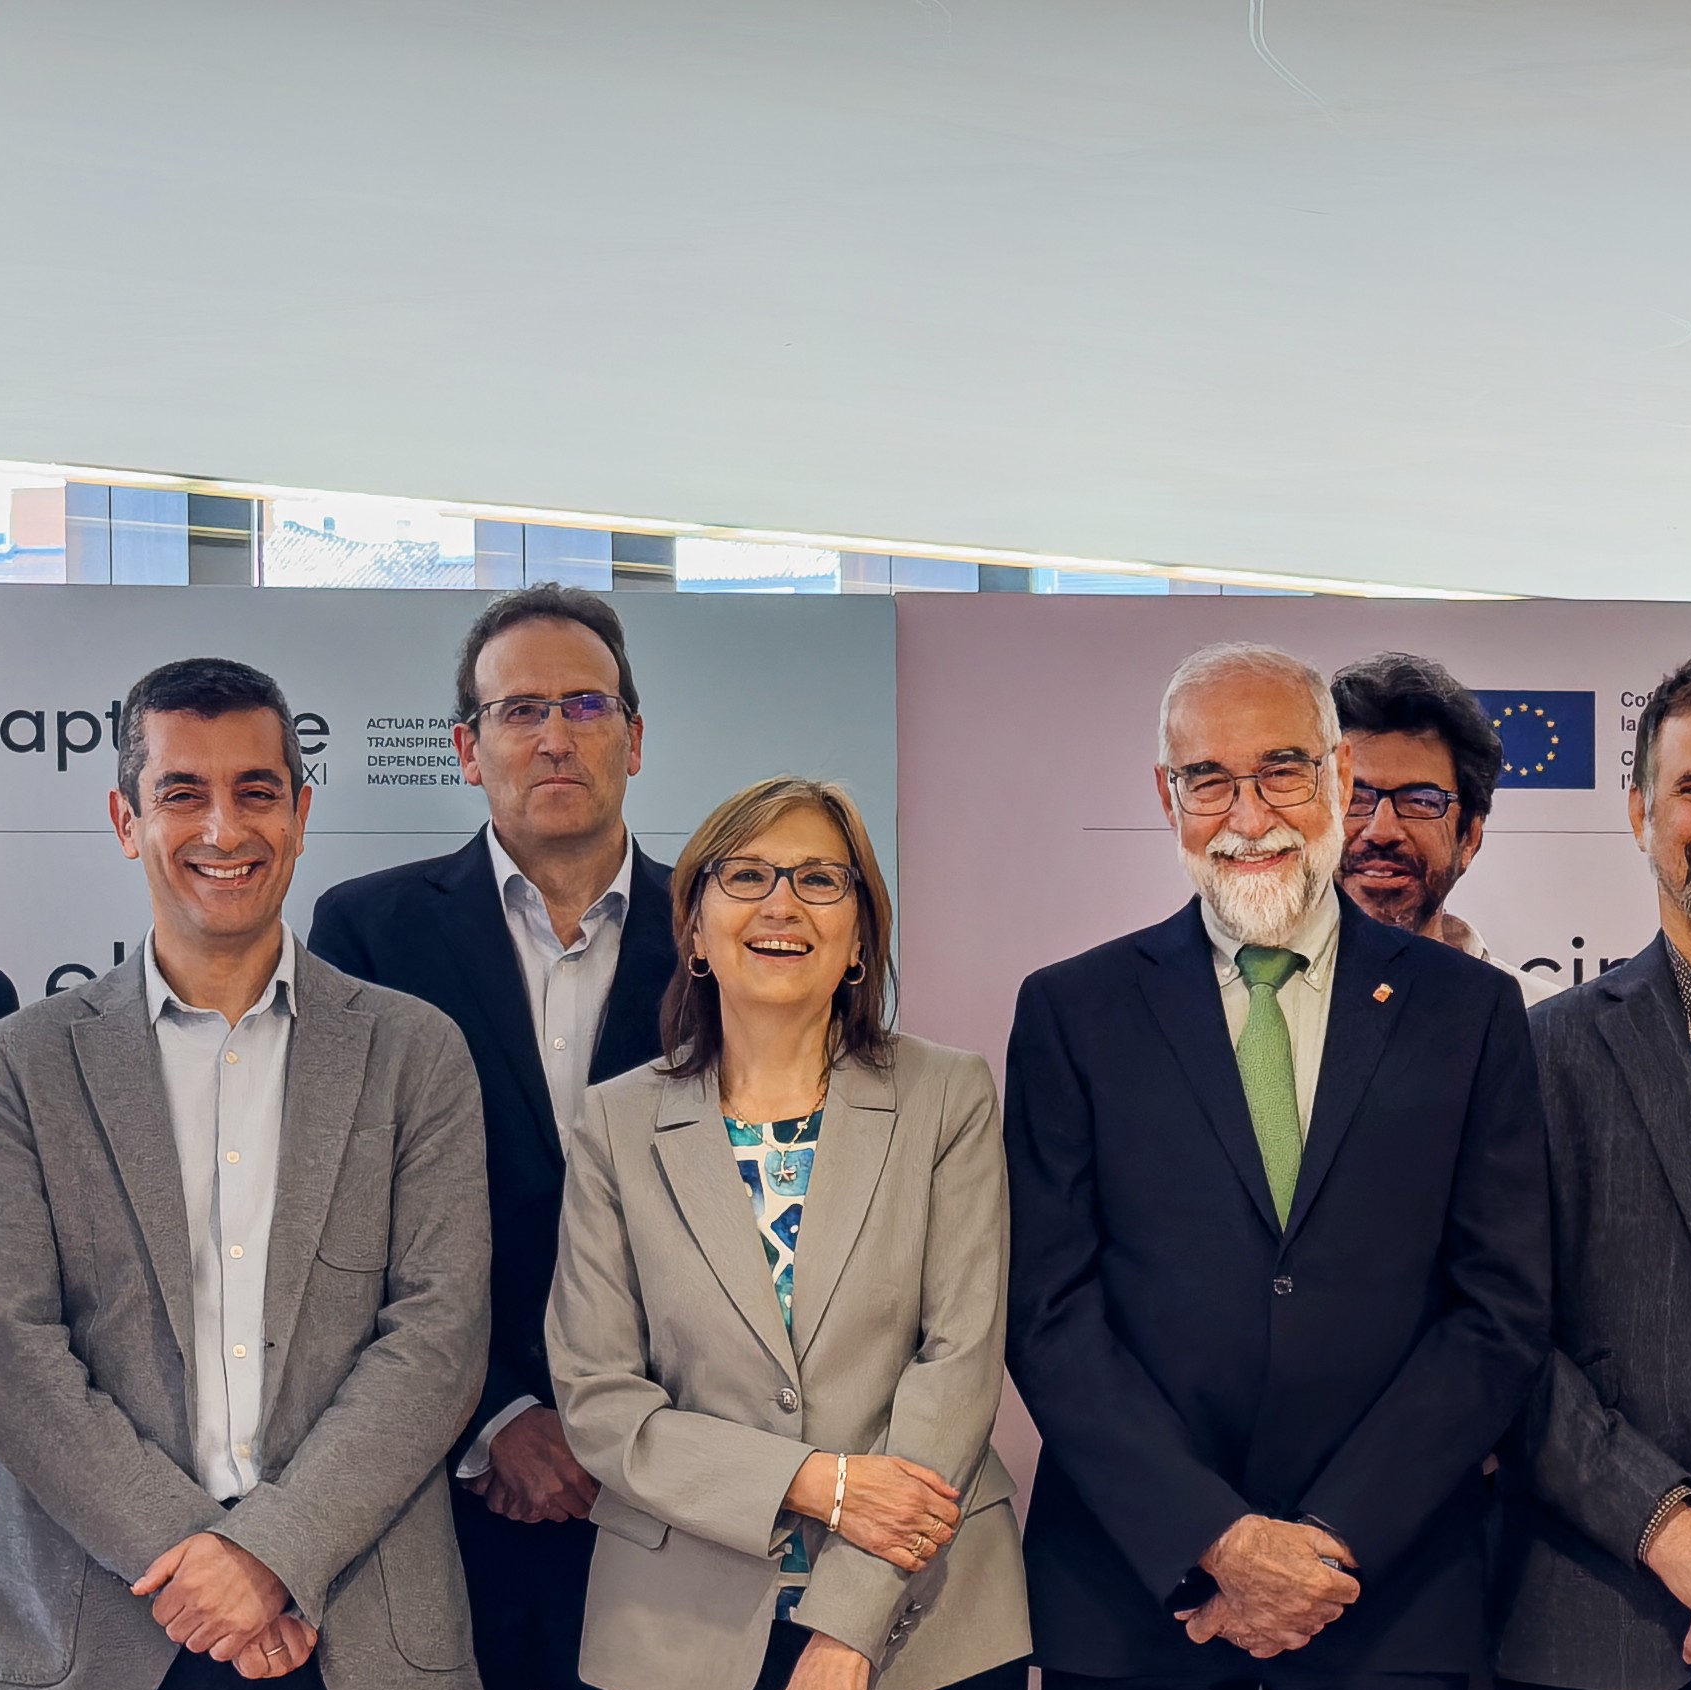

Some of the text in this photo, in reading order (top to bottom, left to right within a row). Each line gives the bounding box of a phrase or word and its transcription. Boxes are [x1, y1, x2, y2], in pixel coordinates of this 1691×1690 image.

[367, 718, 424, 729] ACTUAR
[367, 774, 461, 785] MAYORES EN
